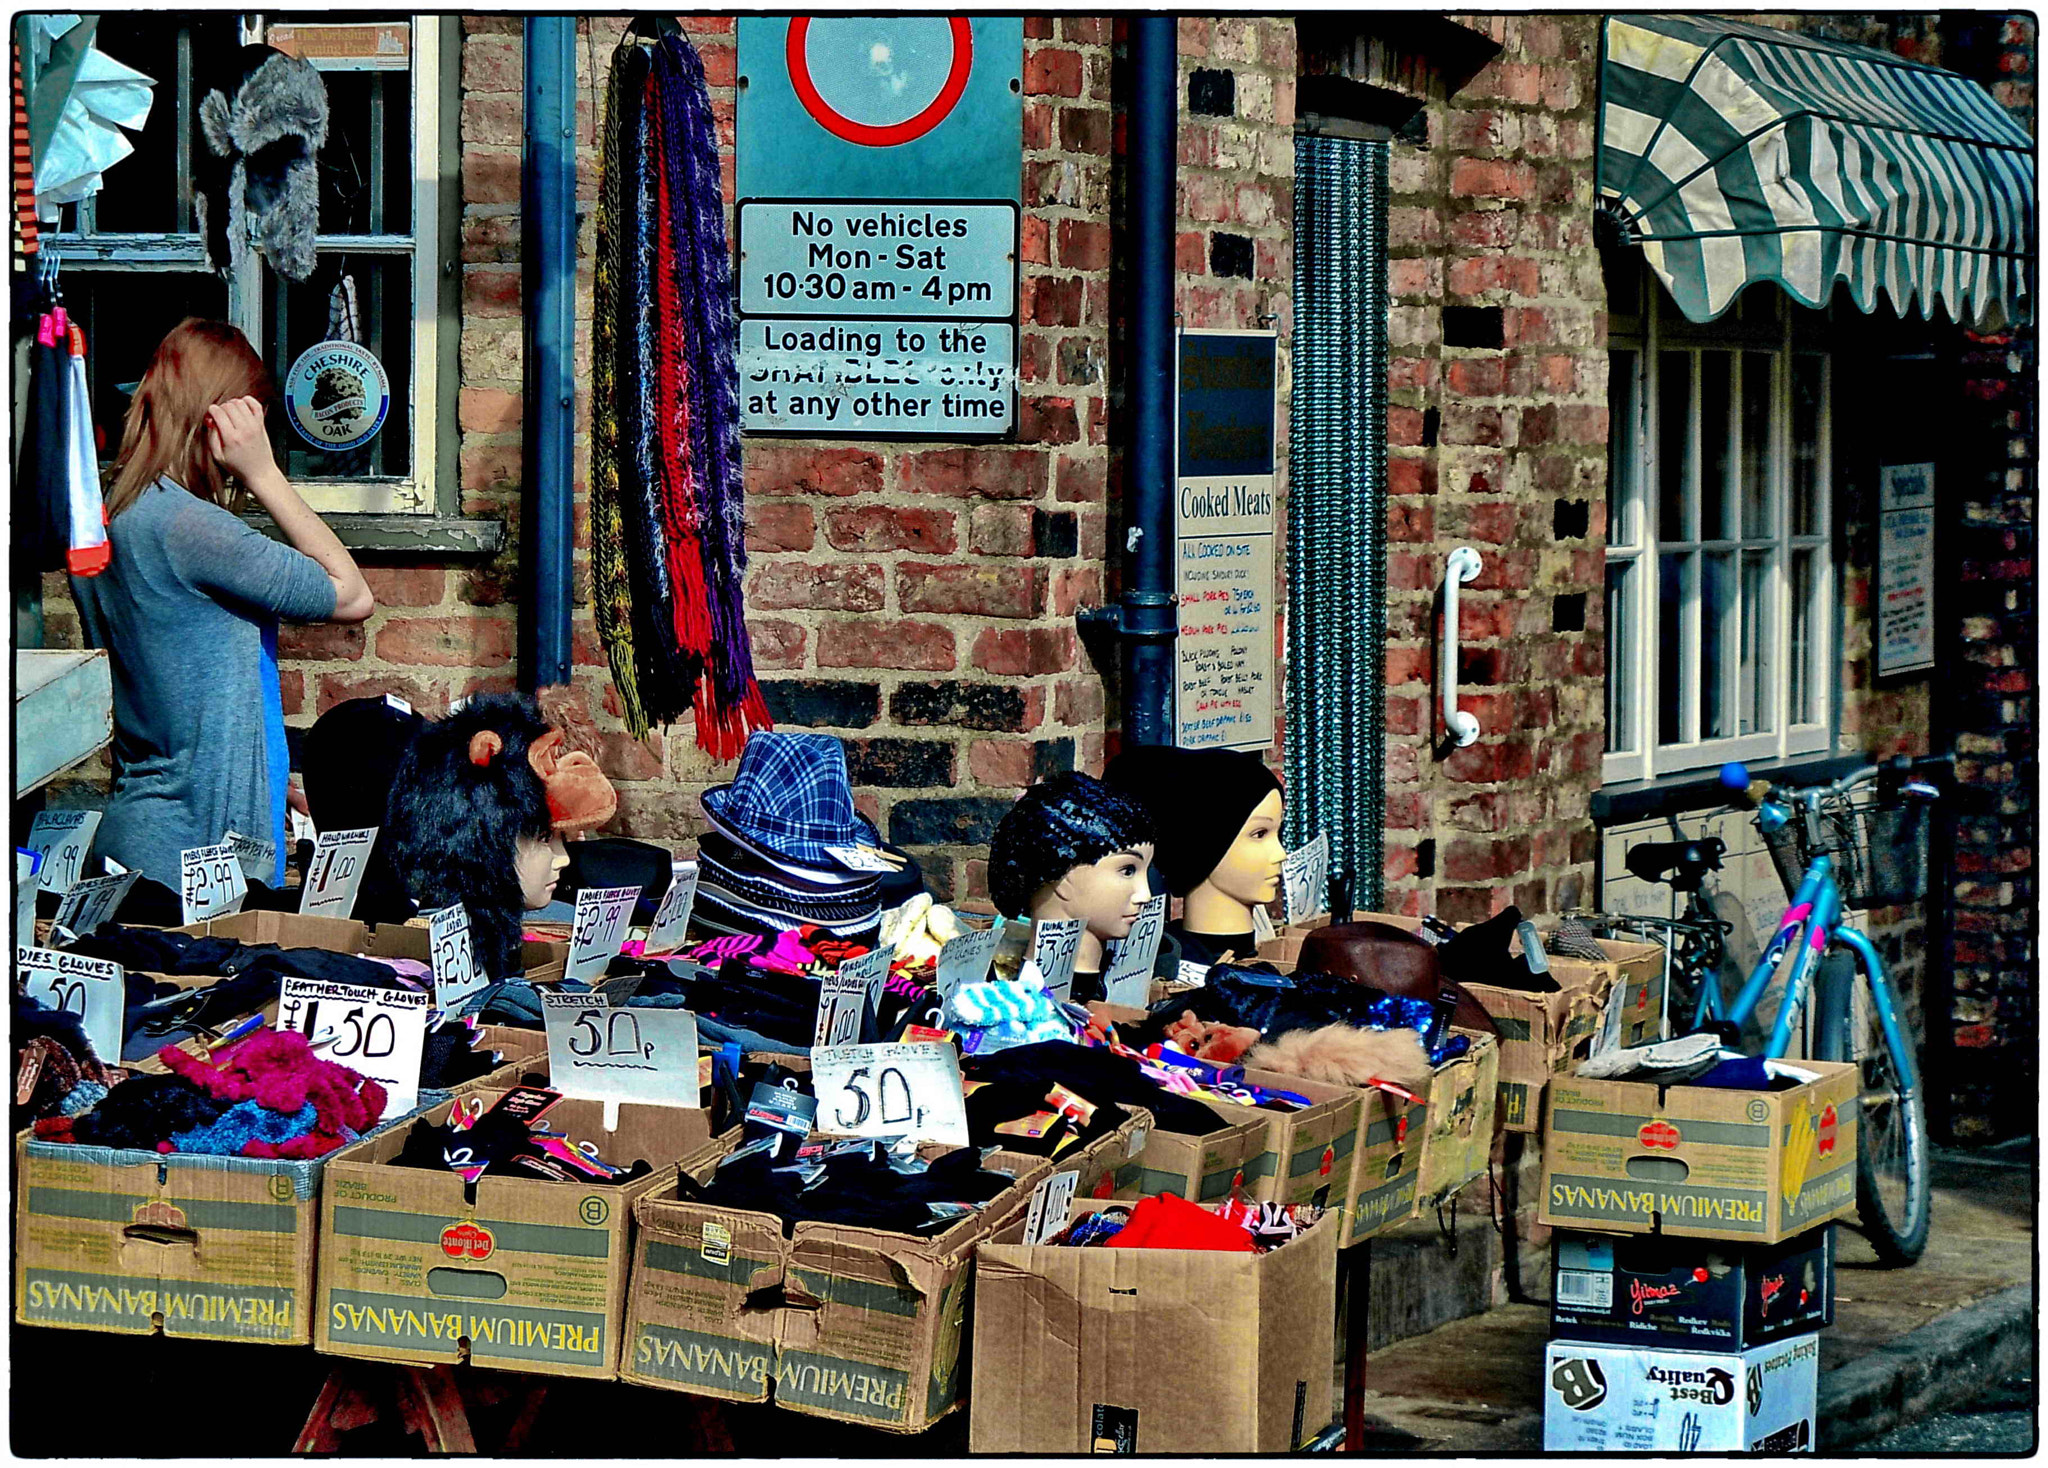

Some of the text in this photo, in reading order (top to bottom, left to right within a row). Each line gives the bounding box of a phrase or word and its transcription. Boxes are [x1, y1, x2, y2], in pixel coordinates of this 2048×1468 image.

[321, 27, 375, 41] Yorkshire
[344, 42, 376, 55] Press
[792, 211, 968, 238] No vehicles
[808, 243, 947, 270] Mon Sat
[852, 279, 896, 300] am
[921, 275, 943, 300] 4
[948, 280, 992, 306] pm
[764, 326, 987, 356] Loading to the
[303, 354, 371, 381] CHESHIRE
[314, 399, 364, 419] BACON PRODUCTS
[748, 390, 1005, 421] at any other time
[322, 423, 353, 437] OAK
[1180, 485, 1271, 519] Cooked Meats
[1198, 541, 1224, 559] COOKED
[1226, 544, 1235, 557] ON
[1236, 543, 1251, 556] SITE
[37, 844, 80, 887] 2.99
[309, 848, 356, 893] £1.00
[184, 862, 236, 911] £2.99
[580, 890, 603, 903] LADIES
[574, 905, 622, 951] £2.99
[1041, 921, 1064, 932] ANIMAL
[18, 947, 115, 976] DIES GLOVES
[1036, 937, 1077, 978] £3.99
[383, 991, 427, 1006] GLOVES
[545, 994, 605, 1006] STRETCH
[284, 1000, 396, 1057] £1.50
[568, 1009, 656, 1061] 50p
[834, 1067, 930, 1129] 50p
[1752, 1104, 1763, 1118] B
[334, 1180, 367, 1190] BRAZIL
[334, 1190, 397, 1202] PRODUCT OF
[585, 1200, 602, 1220] B
[1552, 1184, 1764, 1223] PREMIUM BANANAS
[677, 1222, 703, 1232] OSTA
[442, 1236, 490, 1252] Del Monte
[29, 1281, 291, 1327] PREMIUM BANANAS
[332, 1302, 600, 1353] PREMIUM BANANAS
[1555, 1315, 1578, 1325] Retek
[1629, 1321, 1658, 1331] Ridiche
[638, 1335, 768, 1384] BANANAS
[781, 1361, 903, 1411] PREMIUM
[1647, 1366, 1735, 1406] Quality
[1670, 1387, 1715, 1405] Best
[1625, 1425, 1655, 1434] CLASS
